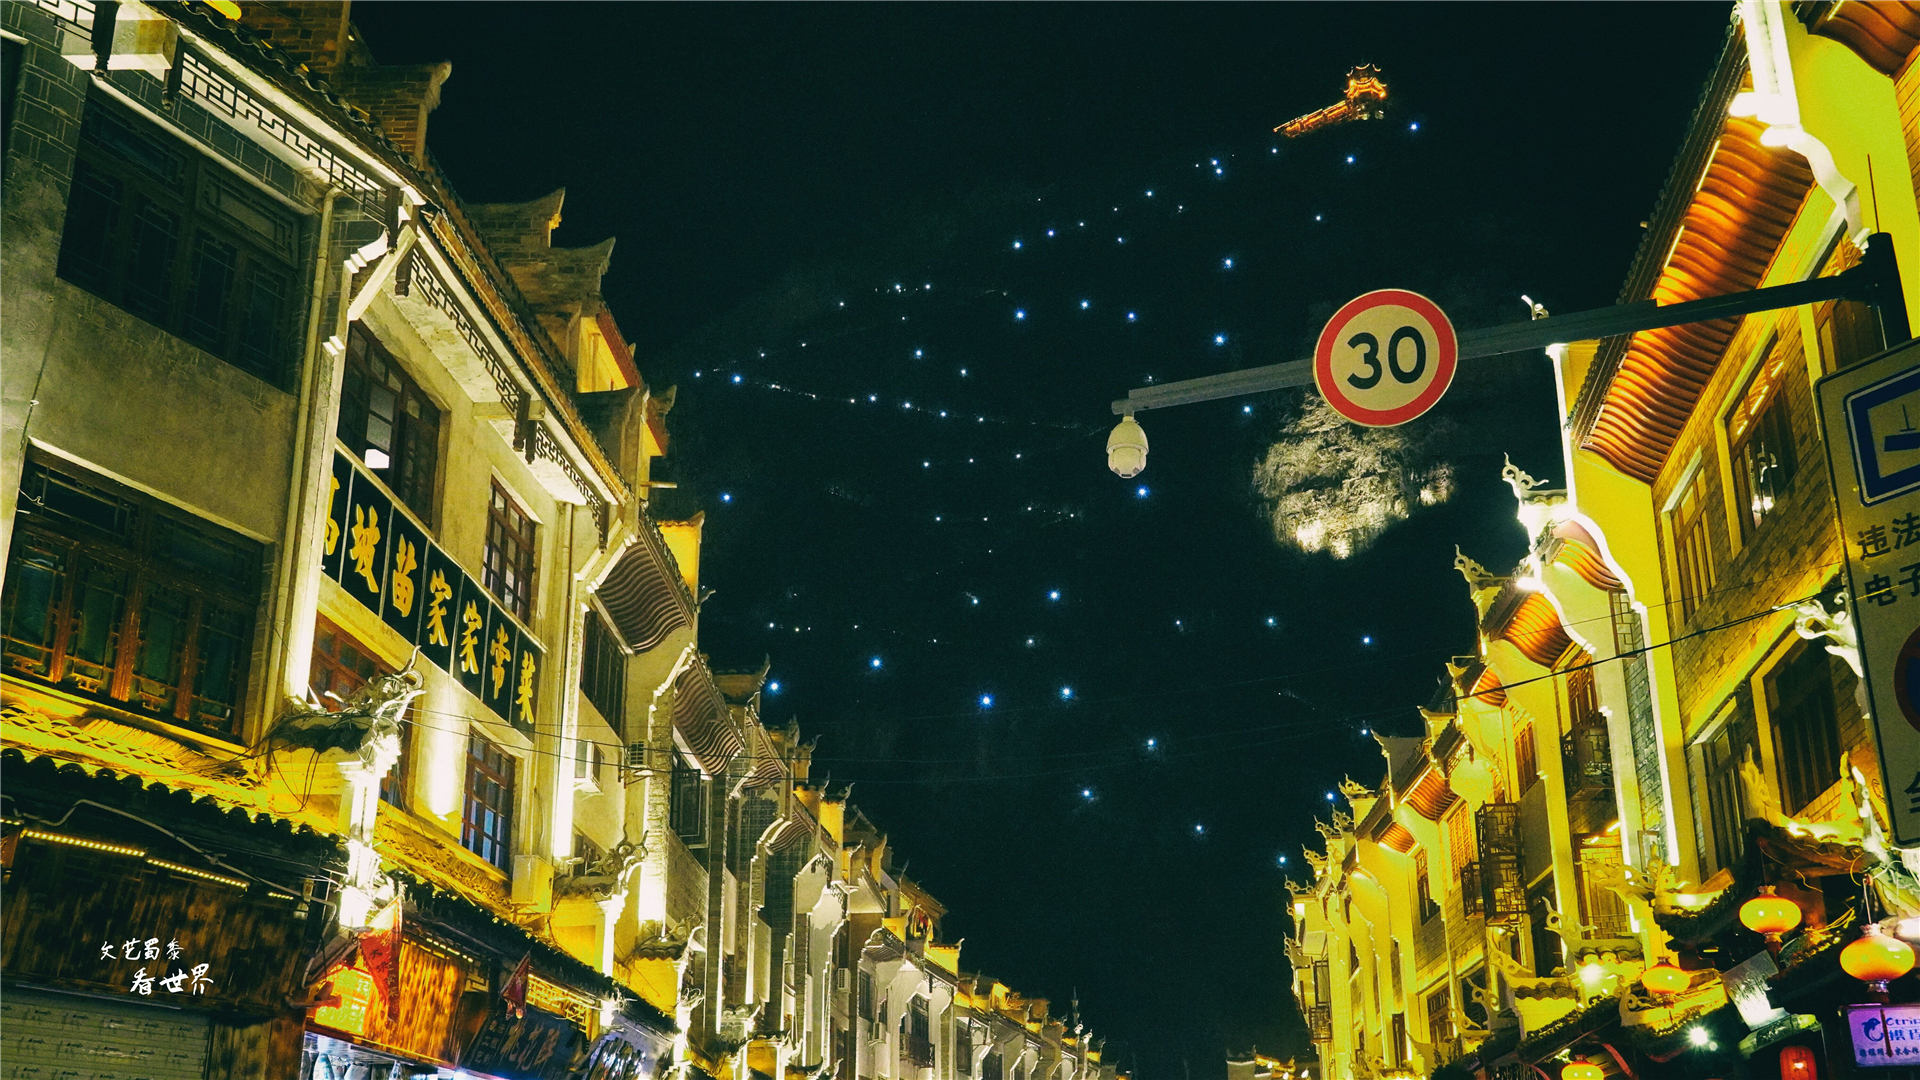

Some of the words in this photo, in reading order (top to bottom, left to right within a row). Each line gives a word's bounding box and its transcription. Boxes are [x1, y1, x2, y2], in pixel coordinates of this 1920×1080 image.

[1347, 326, 1427, 390] 30
[1857, 512, 1920, 562] 违法
[1864, 562, 1920, 607] 电子
